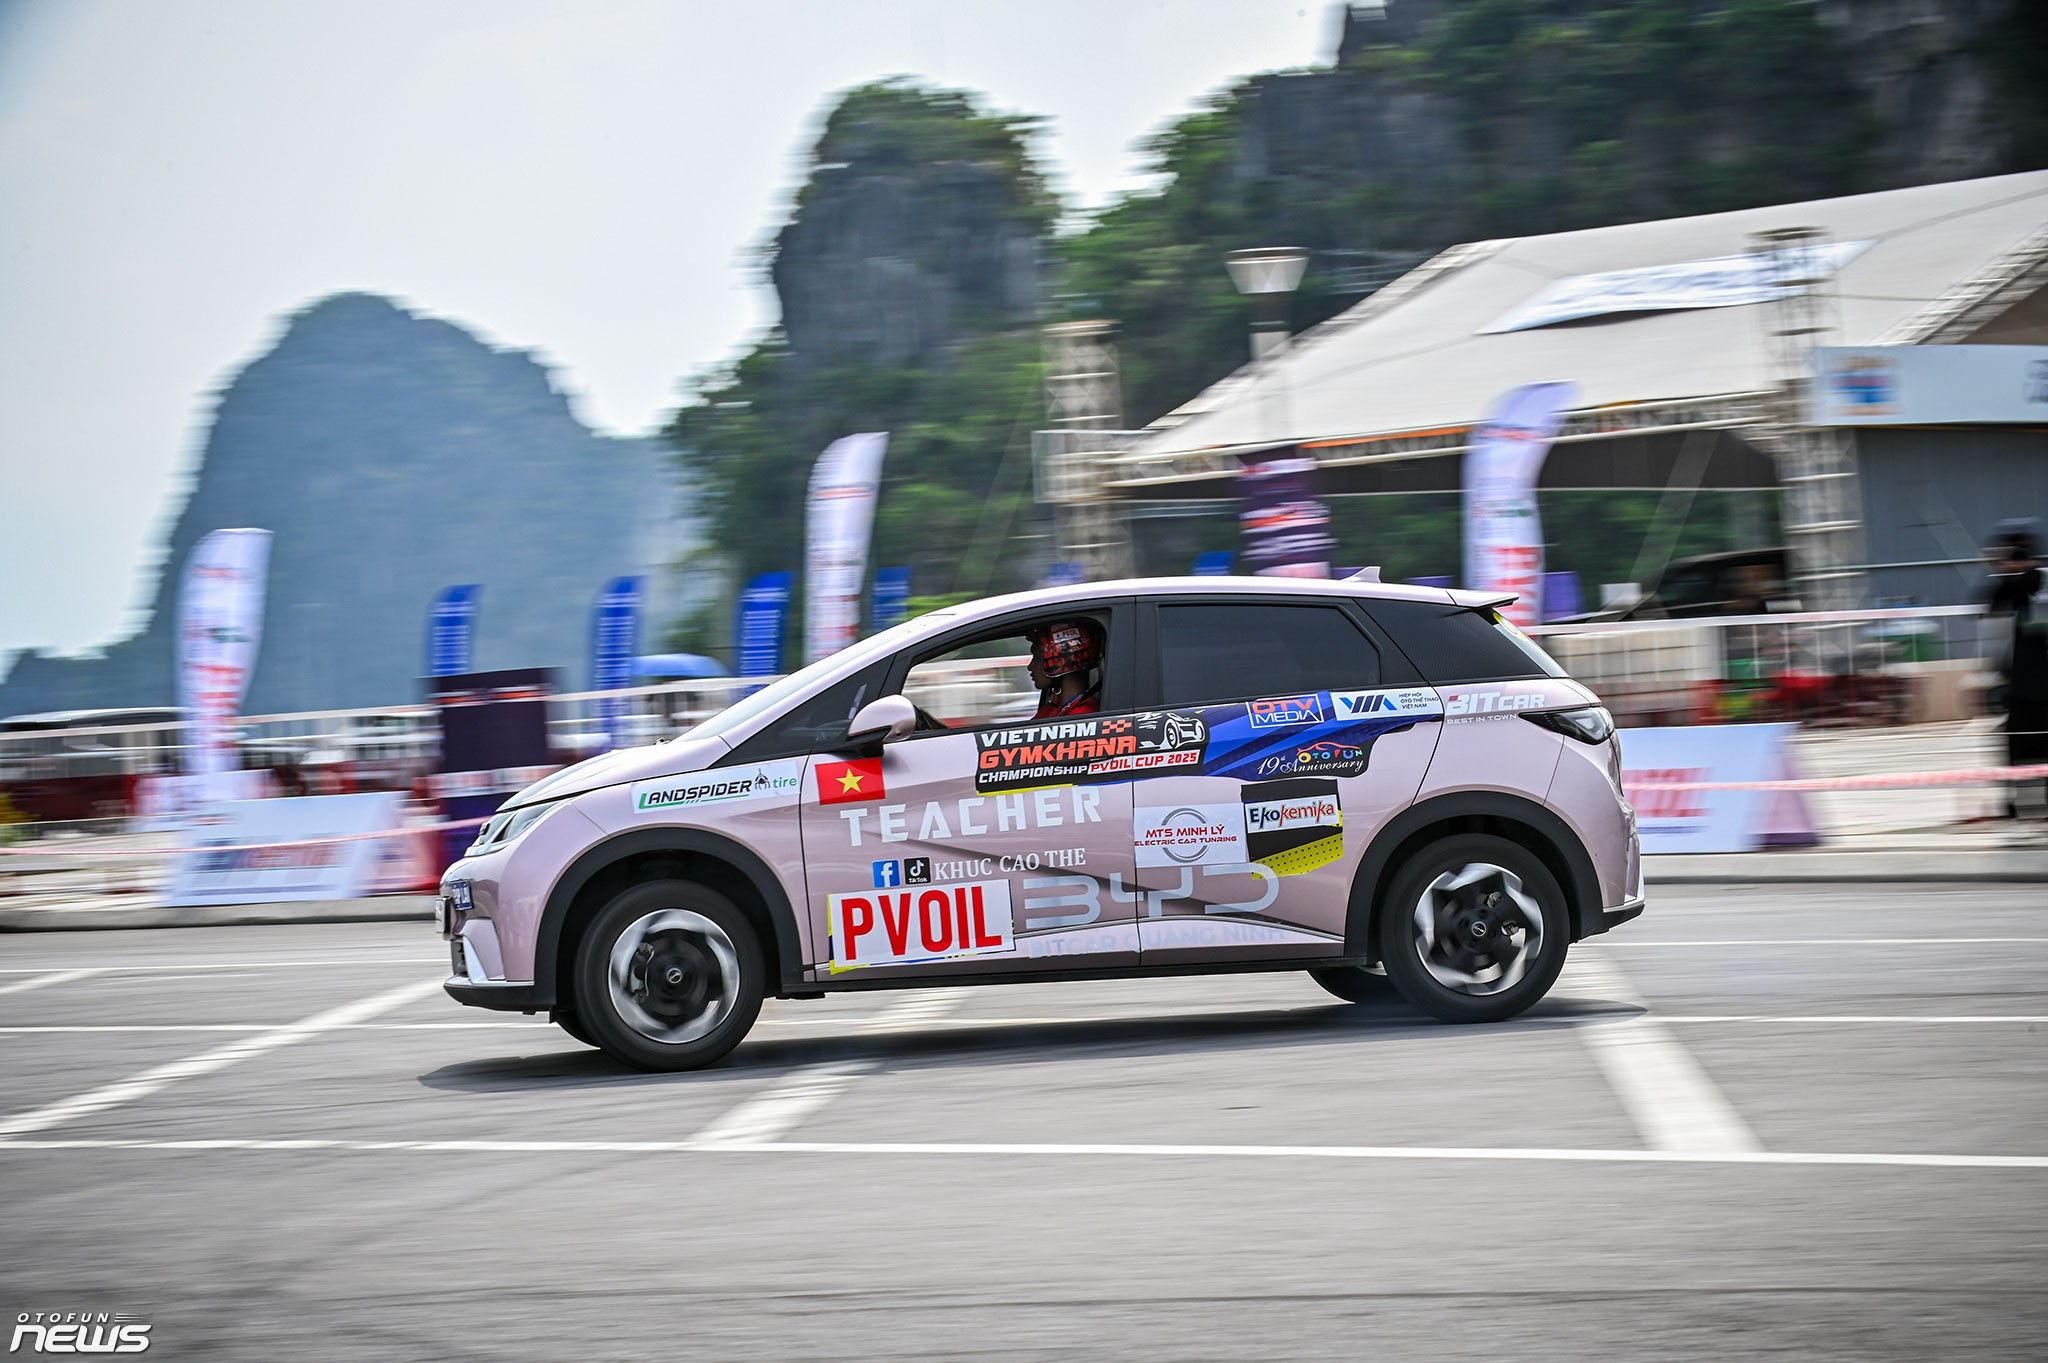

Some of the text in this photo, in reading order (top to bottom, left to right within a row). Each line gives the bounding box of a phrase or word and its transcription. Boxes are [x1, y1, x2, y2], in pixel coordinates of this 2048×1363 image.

[1252, 698, 1315, 713] OTV
[1255, 709, 1321, 724] MEDIA
[1447, 717, 1474, 725] BEST
[1487, 714, 1517, 722] TOWN
[980, 721, 1097, 747] VIETNAM
[979, 735, 1137, 769] GYMKHANA
[1280, 759, 1365, 773] Anniversary
[979, 752, 1197, 784] CHAMPIONSHIP PVOIL CUP 2025
[638, 777, 798, 809] LANDSPIDER tire
[840, 785, 1102, 847] TEACHER
[1249, 800, 1335, 829] Ekokemika
[1134, 839, 1175, 847] ELECTRIC
[1146, 824, 1225, 838] MTS MINH LÝ
[934, 848, 1086, 881] KHUC CAO THE
[1023, 862, 1280, 930] BYD
[841, 885, 1002, 961] PVOIL
